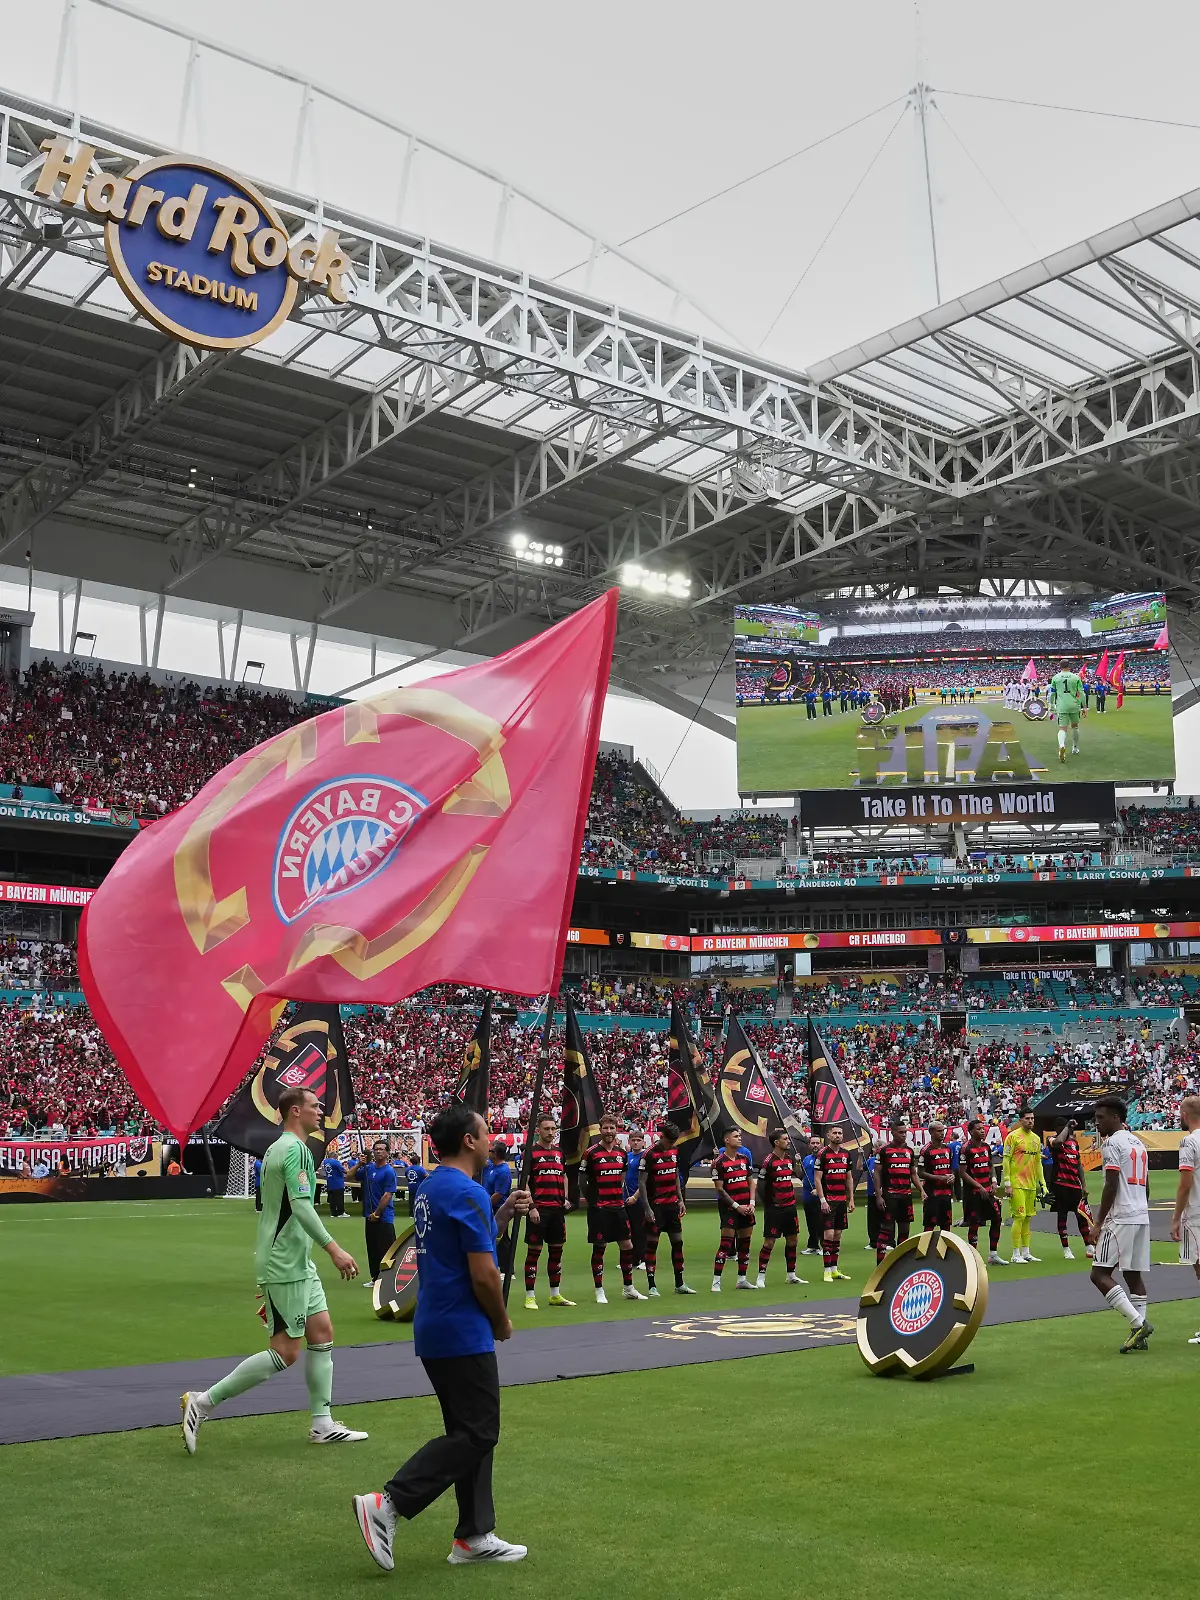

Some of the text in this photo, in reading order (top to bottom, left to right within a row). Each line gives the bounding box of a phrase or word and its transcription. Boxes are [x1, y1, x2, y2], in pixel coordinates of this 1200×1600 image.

[33, 136, 350, 304] Hard Rock
[147, 261, 258, 311] STADIUM
[861, 791, 1055, 818] Take It To The World
[1165, 796, 1182, 806] 312
[22, 806, 71, 823] TAYLOR
[588, 867, 600, 877] 84
[987, 873, 1001, 883] 89
[1151, 869, 1165, 878] 39
[700, 880, 709, 888] 13
[844, 878, 857, 887] 40
[6, 885, 95, 904] BAYERN MÜNCHE
[849, 933, 906, 945] CR FLAMENGO
[1054, 925, 1140, 939] FC BAYERN MÜNCHEN
[703, 935, 789, 949] FC BAYERN MÜNCHEN
[1002, 971, 1020, 980] Take
[1027, 971, 1036, 979] To
[1038, 970, 1051, 979] The
[30, 1147, 61, 1171] USA
[1127, 1147, 1147, 1186] 11
[898, 1273, 941, 1299] FC BAYERN
